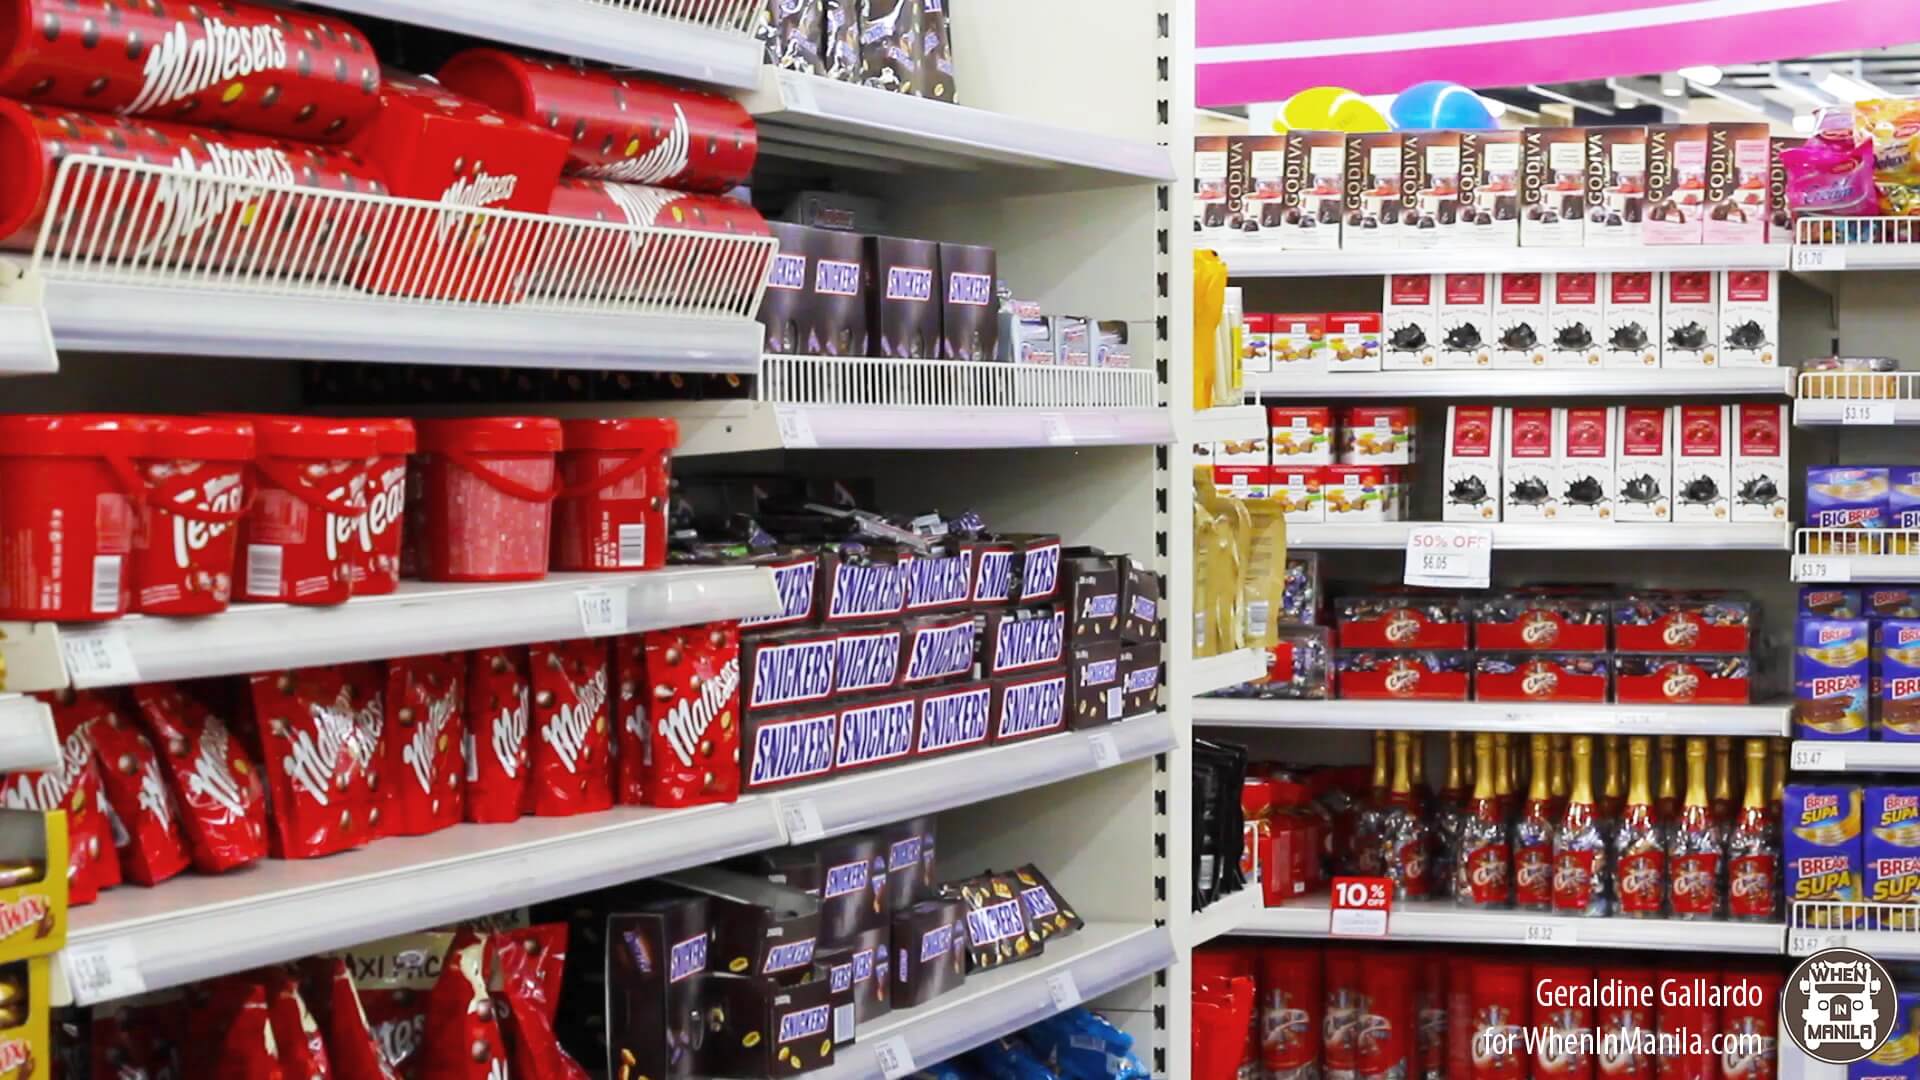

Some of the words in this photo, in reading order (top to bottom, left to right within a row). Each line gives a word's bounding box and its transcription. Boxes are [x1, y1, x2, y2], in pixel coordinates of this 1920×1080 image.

[122, 18, 287, 115] Maltesers
[1229, 142, 1243, 211] GODIVA
[1285, 136, 1303, 206] GODIVA
[1346, 138, 1362, 209] GODIVA
[1402, 136, 1418, 208] GODIVA
[1460, 133, 1477, 206] GODIVA
[1525, 131, 1541, 202] GODIVA
[1588, 133, 1603, 205] GODIVA
[1648, 131, 1666, 202] GODIVA
[1709, 130, 1727, 202] GODIVA
[1822, 512, 1846, 527] BIG
[832, 563, 900, 616] SNICKERS
[907, 553, 971, 607] SNICKERS
[837, 634, 900, 690] NICKERS
[998, 614, 1064, 669] SNICKERS
[755, 644, 834, 704] SNICKERS
[1814, 676, 1861, 697] BREAK
[658, 657, 740, 767] Maltesers
[838, 703, 914, 764] SNICKERS
[920, 691, 990, 751] SNICKERS
[1001, 680, 1066, 736] SNICKERS
[753, 719, 835, 782] SNICKERS
[1801, 806, 1838, 825] SUPA
[1880, 806, 1918, 826] SUPA
[1795, 871, 1851, 898] SUPA
[1799, 857, 1848, 878] BREAK
